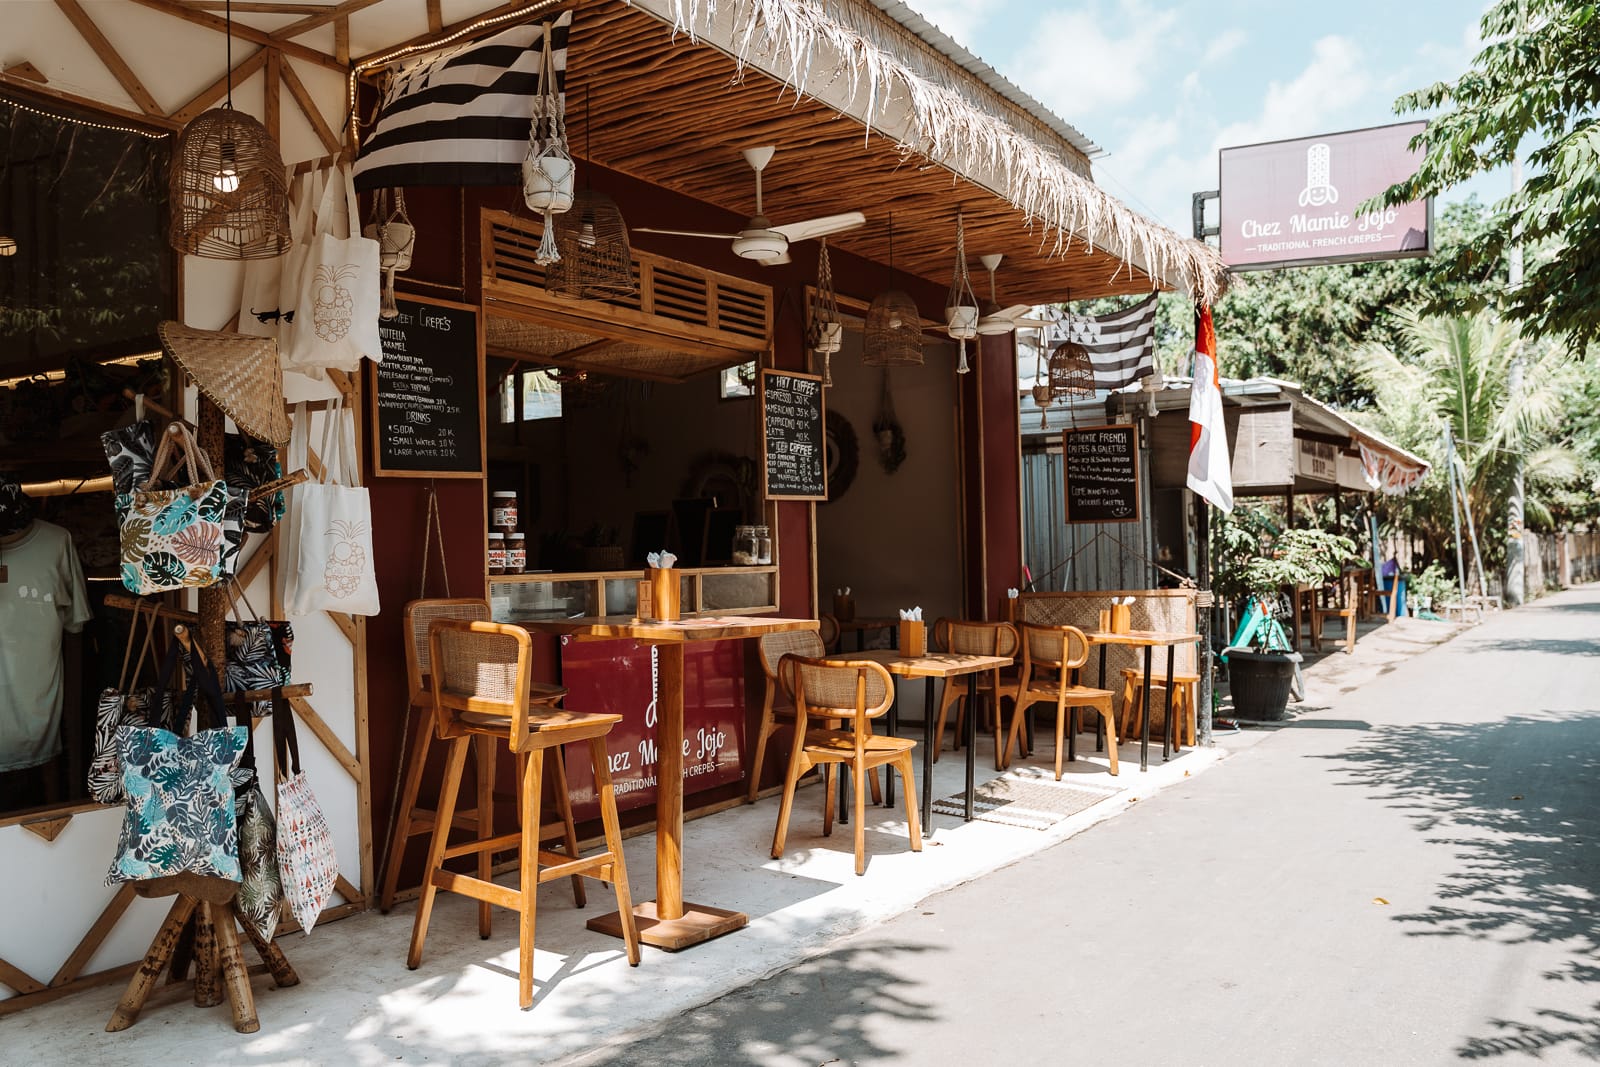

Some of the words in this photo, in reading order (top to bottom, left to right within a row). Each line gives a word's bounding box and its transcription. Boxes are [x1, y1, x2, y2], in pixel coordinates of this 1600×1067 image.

[1241, 219, 1281, 238] Chez
[1289, 211, 1351, 234] Mamie
[1357, 209, 1399, 232] Jojo
[1257, 239, 1310, 252] TRADITIONAL
[1312, 236, 1347, 247] FRENCH
[1349, 232, 1382, 245] CREPES
[379, 327, 406, 341] NUTELLA
[383, 352, 412, 364] TRAWBERRY
[776, 376, 791, 389] HOT
[793, 379, 816, 396] COFFEE
[766, 389, 791, 404] ESPRESSO
[406, 410, 432, 423] DRINKS
[766, 404, 795, 417] AMERICANO
[393, 424, 414, 434] SODA
[768, 427, 785, 436] LATTE
[392, 436, 413, 445] SMALL
[415, 438, 436, 447] WATER
[1099, 432, 1127, 444] FRENCH
[415, 449, 438, 457] WATER
[789, 442, 813, 456] COFFEE
[1097, 444, 1127, 454] GALETTES
[697, 727, 726, 759] Jojo
[613, 775, 657, 795] RADITIONAL
[689, 761, 715, 777] CREPES
